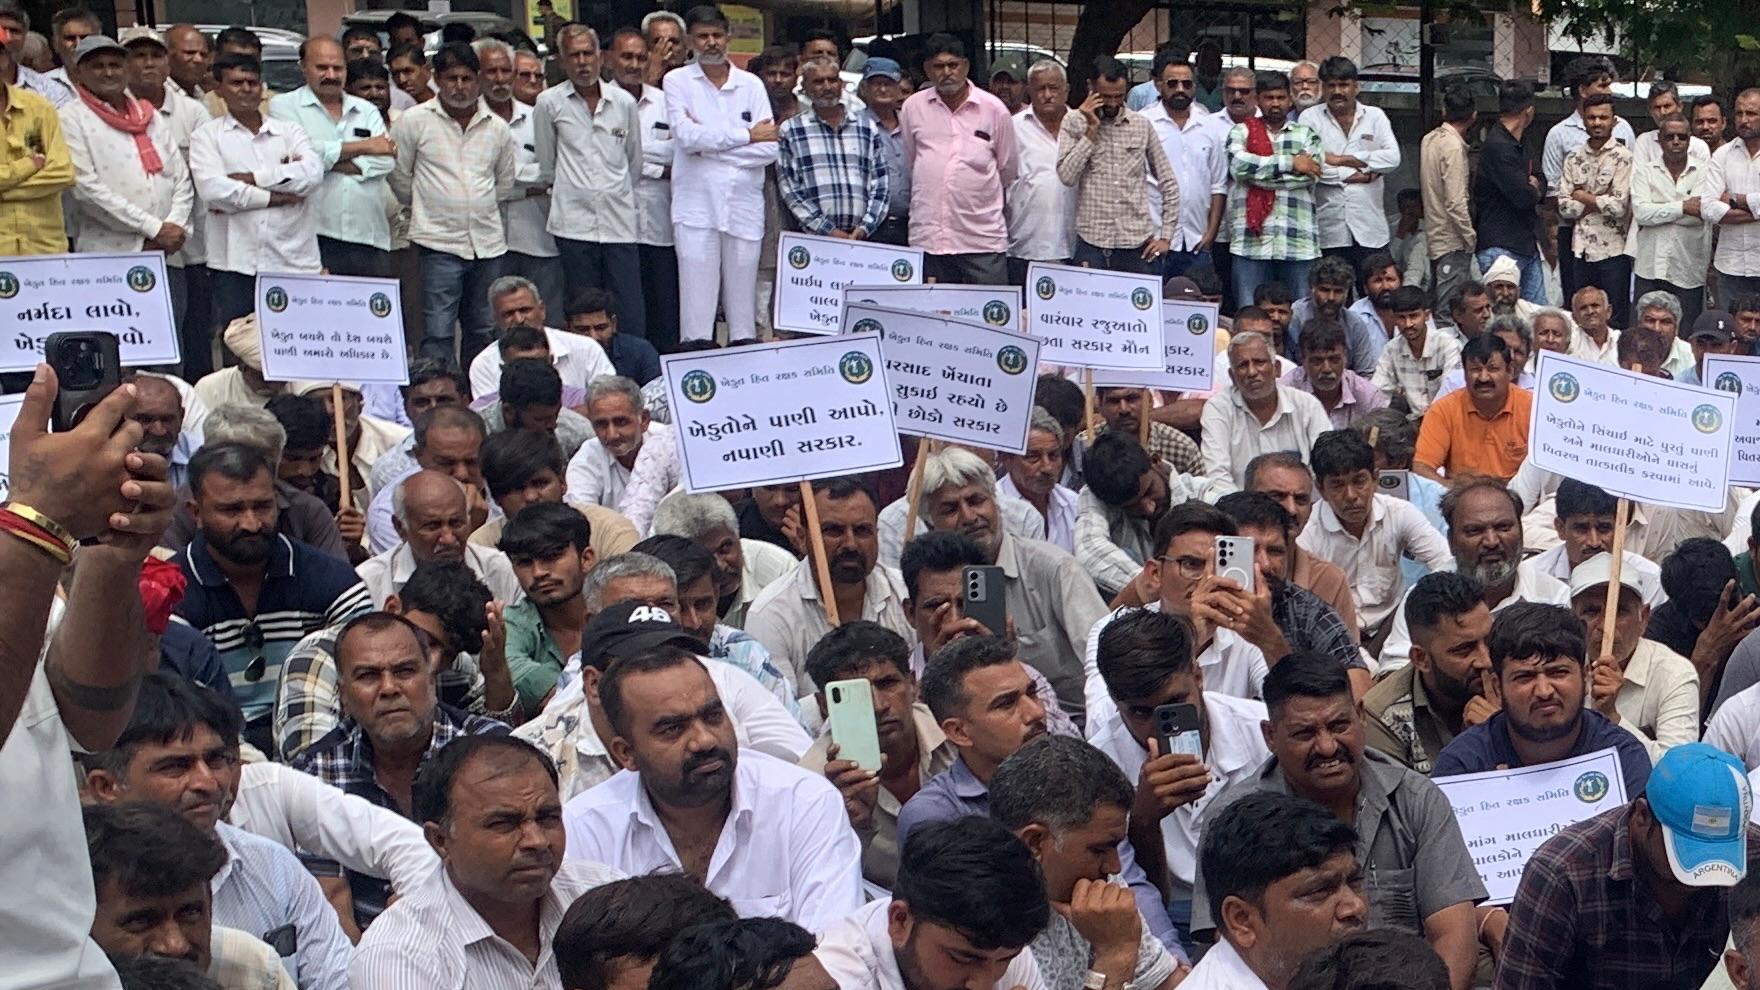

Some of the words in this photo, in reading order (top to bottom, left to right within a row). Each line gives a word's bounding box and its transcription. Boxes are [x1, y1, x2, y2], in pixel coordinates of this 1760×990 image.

[17, 301, 72, 321] નર્મદા
[85, 299, 140, 319] લાવો,
[1040, 311, 1084, 328] વારંવાર
[1091, 319, 1148, 334] રજુઆતો
[1071, 339, 1113, 352] સરકાર
[896, 384, 938, 400] સુકાઈ
[995, 398, 1008, 413] છે
[688, 414, 758, 442] ખેડુતોને
[769, 406, 817, 428] પાણી
[828, 399, 885, 421] આપો.
[908, 405, 943, 424] છોડો
[953, 416, 1001, 434] સરકાર
[722, 439, 786, 463] નપાણી
[797, 434, 863, 454] સરકાર.
[1563, 435, 1583, 447] અને
[1634, 435, 1654, 447] માટે
